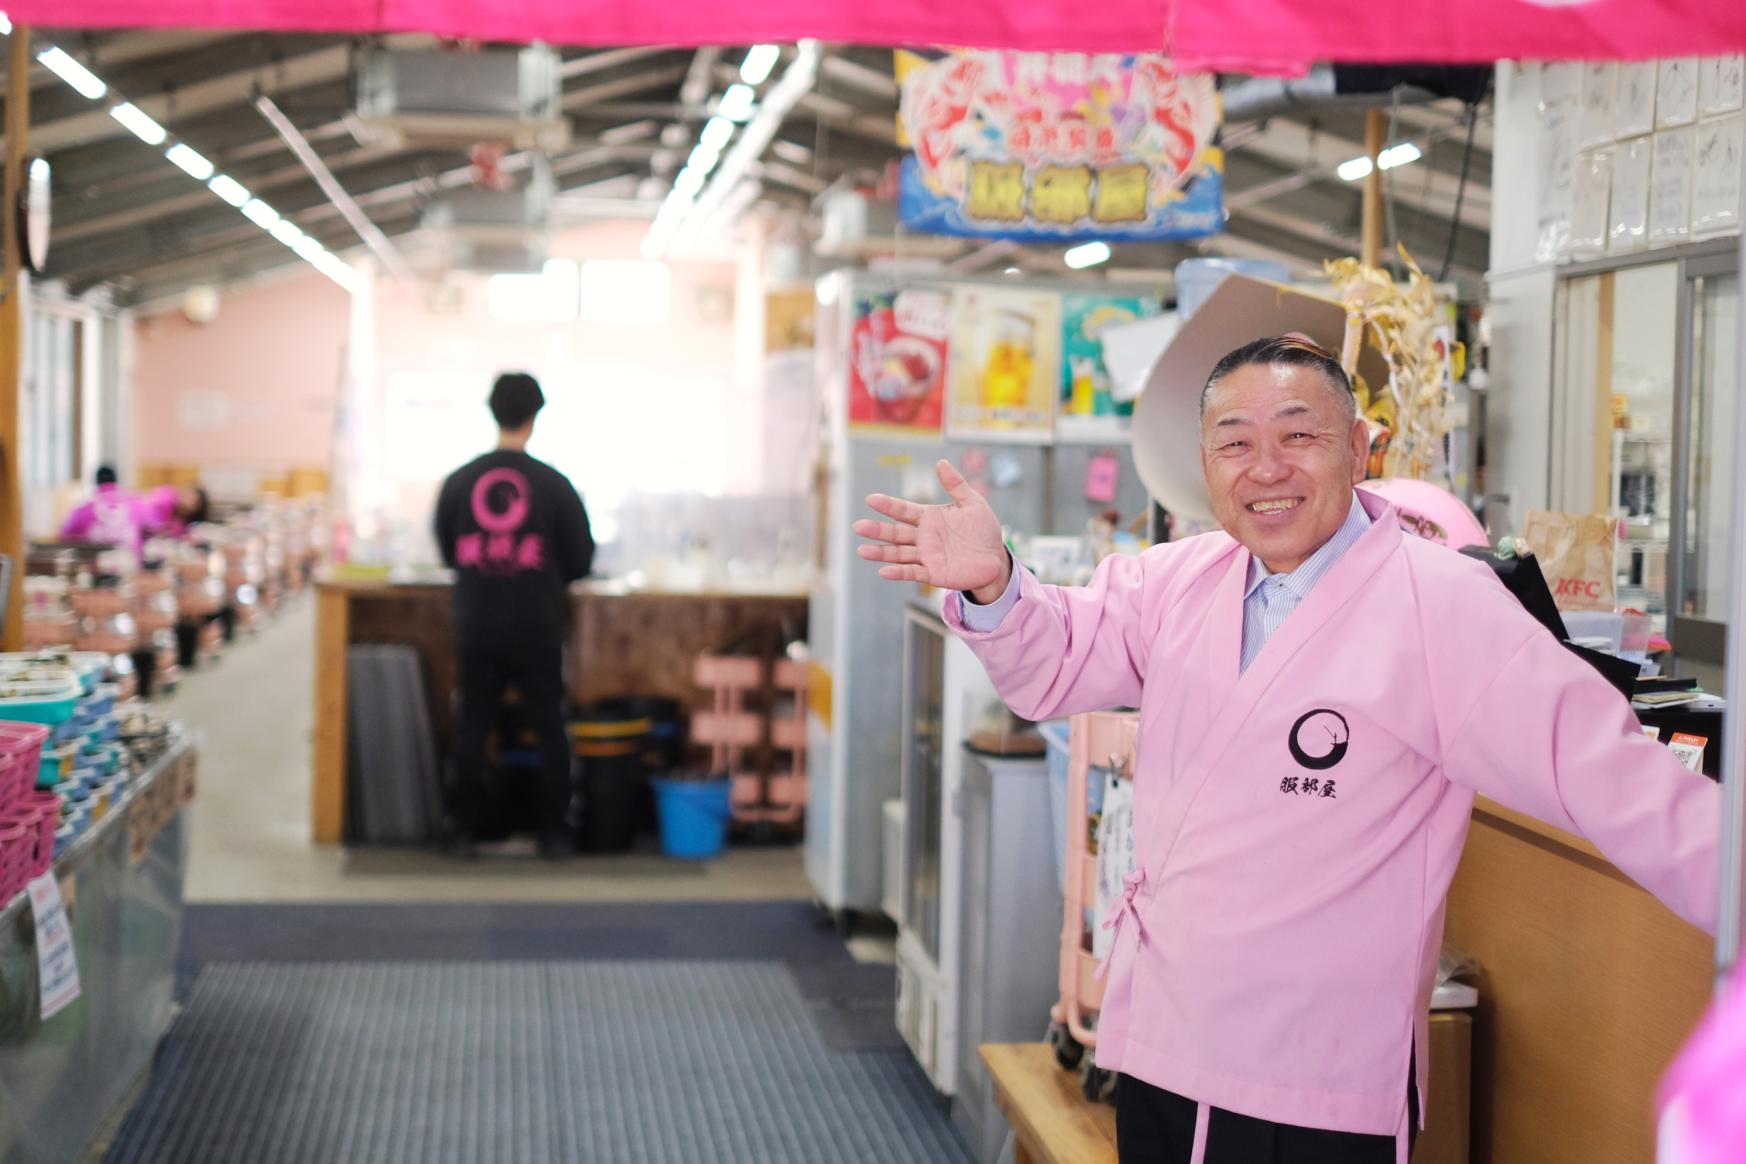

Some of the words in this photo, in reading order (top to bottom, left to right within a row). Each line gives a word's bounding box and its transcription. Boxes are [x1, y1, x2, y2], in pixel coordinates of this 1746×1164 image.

[1556, 577, 1601, 599] KFC
[1280, 777, 1337, 799] 服部屋
